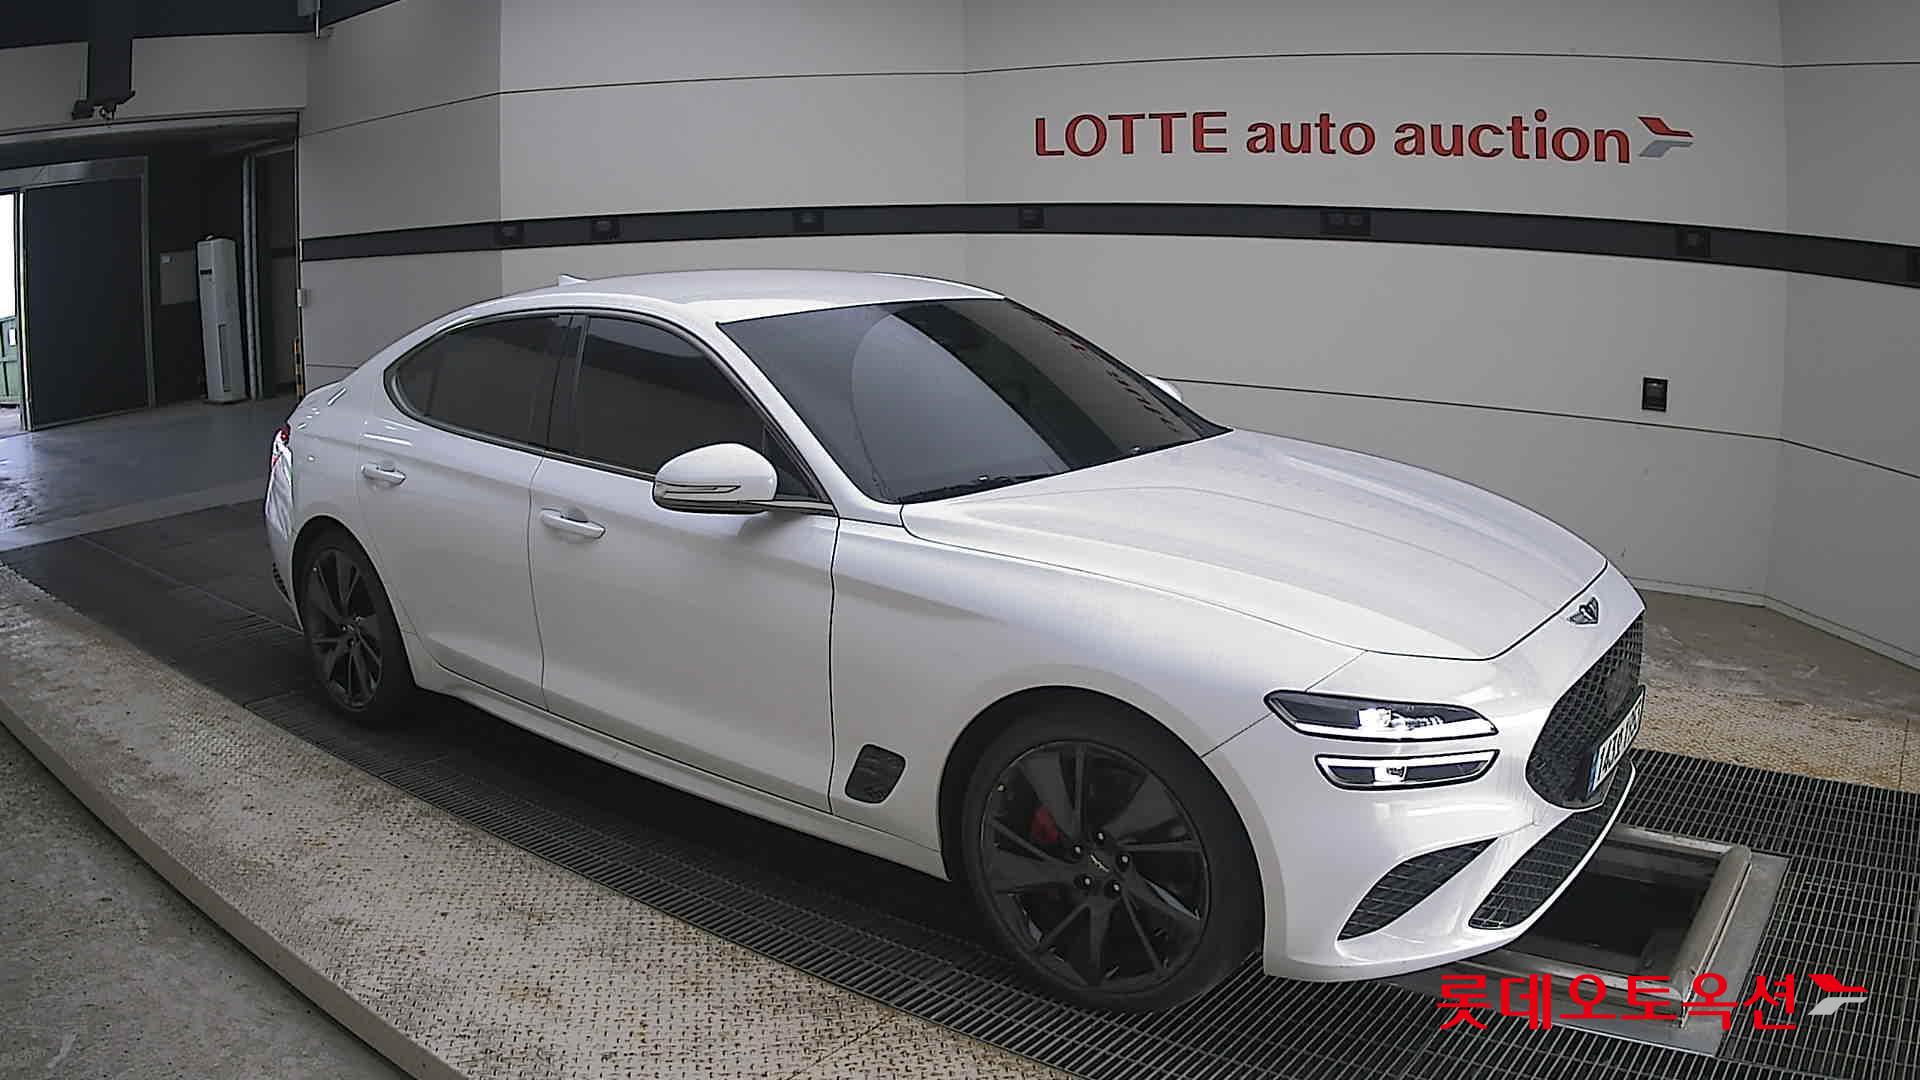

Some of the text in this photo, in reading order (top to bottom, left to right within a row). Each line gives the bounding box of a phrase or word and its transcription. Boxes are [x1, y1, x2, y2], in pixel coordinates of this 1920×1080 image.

[1035, 108, 1631, 164] LOTTE auto auction
